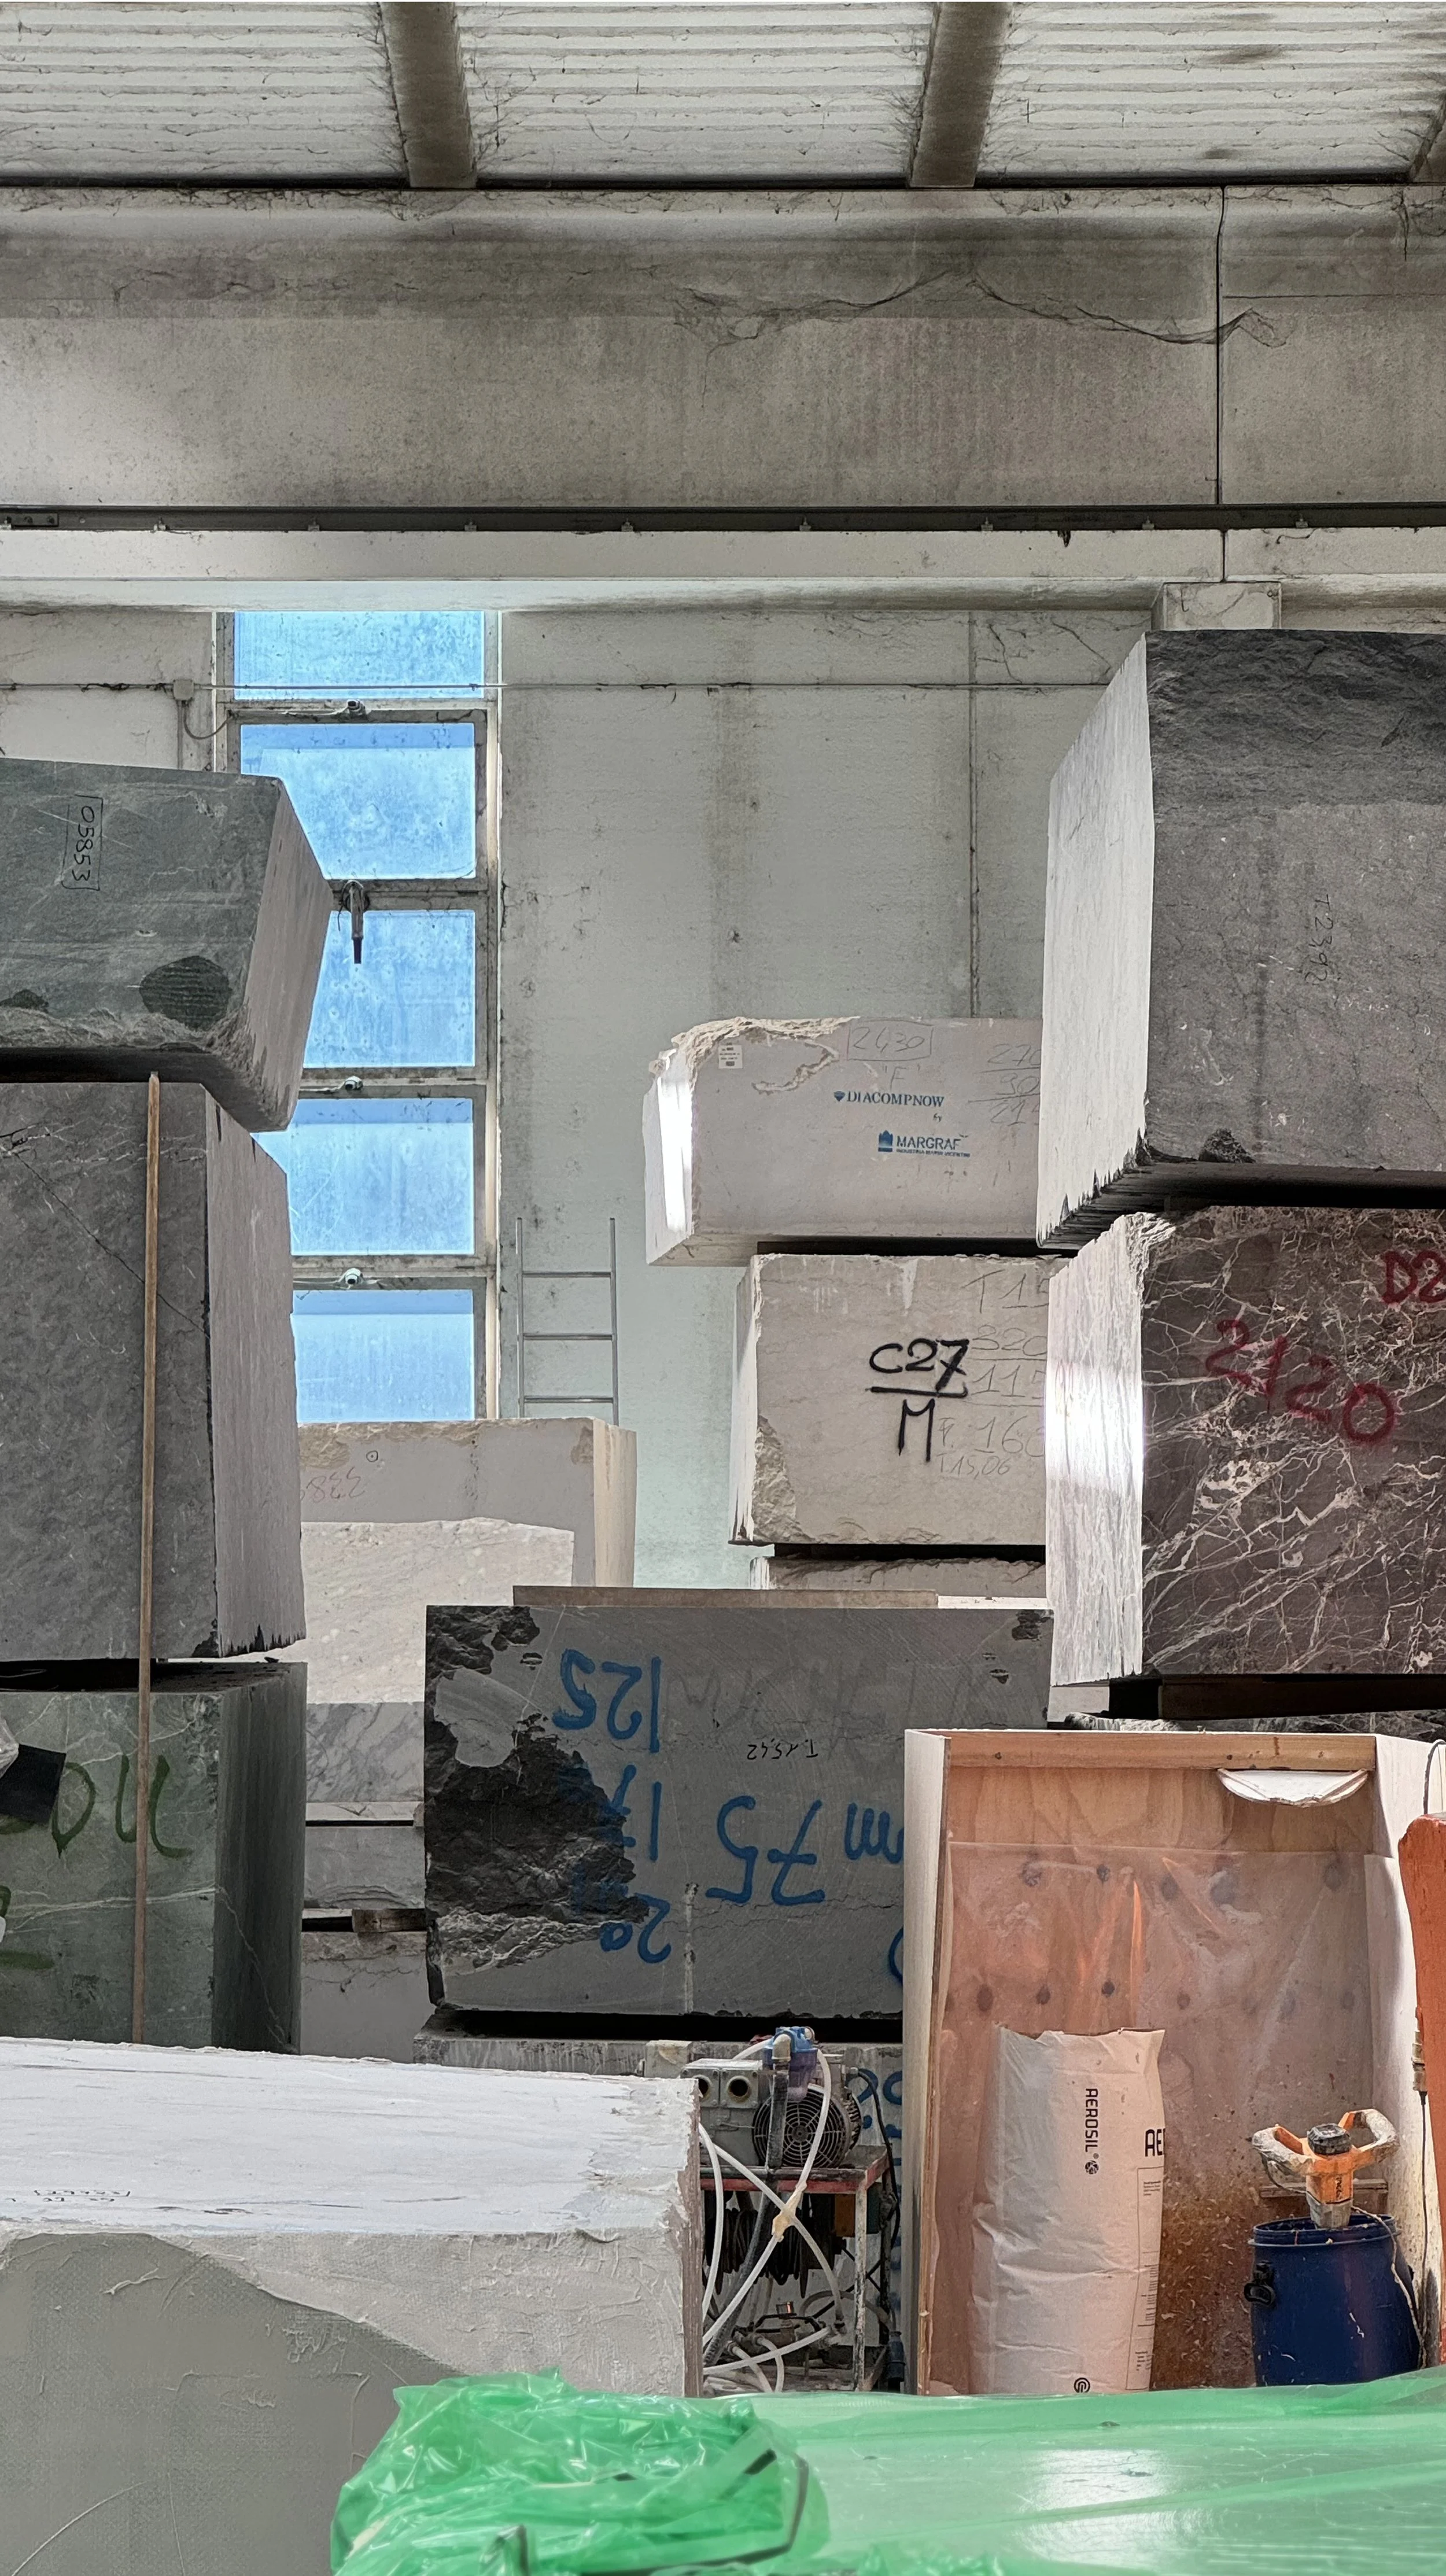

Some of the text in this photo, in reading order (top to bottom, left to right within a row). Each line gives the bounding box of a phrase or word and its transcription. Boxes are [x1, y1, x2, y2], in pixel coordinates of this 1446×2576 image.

[72, 806, 94, 881] 05853
[846, 1090, 945, 1107] DIACOMPNOW
[897, 1134, 961, 1150] MARGRAF
[869, 1338, 970, 1392] C27
[898, 1398, 936, 1462] M
[551, 1648, 662, 1753] 125
[706, 1795, 825, 1906] 75
[1084, 2088, 1098, 2153] AEROSIL
[1145, 2128, 1166, 2157] AE
